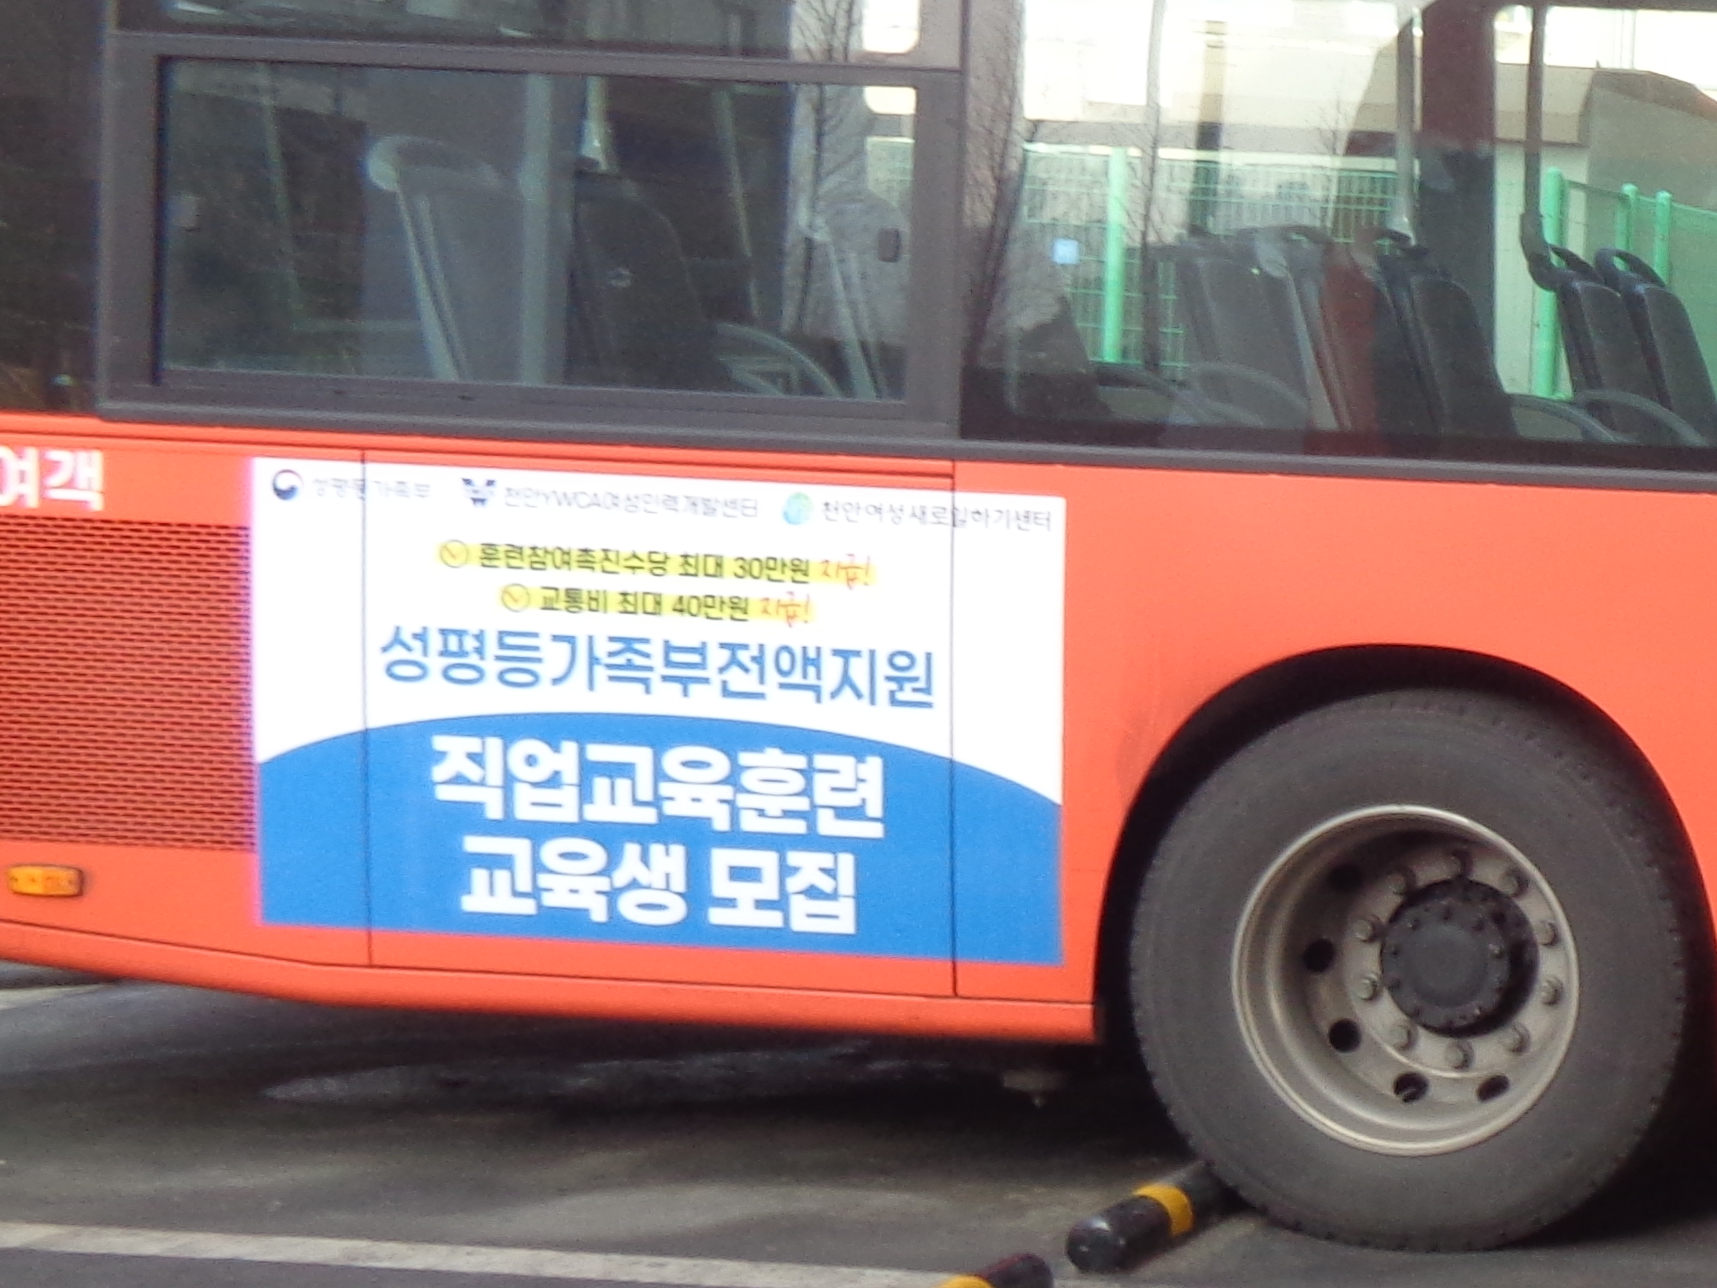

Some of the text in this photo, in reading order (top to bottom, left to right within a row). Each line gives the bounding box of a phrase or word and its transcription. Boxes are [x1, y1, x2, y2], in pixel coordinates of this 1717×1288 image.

[478, 542, 873, 589] 훈련참여촉진수당 최대 30만원 지급!
[539, 585, 811, 627] 교통비 최대 40만원 지급!
[378, 624, 935, 709] 성평등가족부전액지원
[431, 734, 886, 839] 직업교육훈련
[460, 834, 857, 935] 교육생 모집
